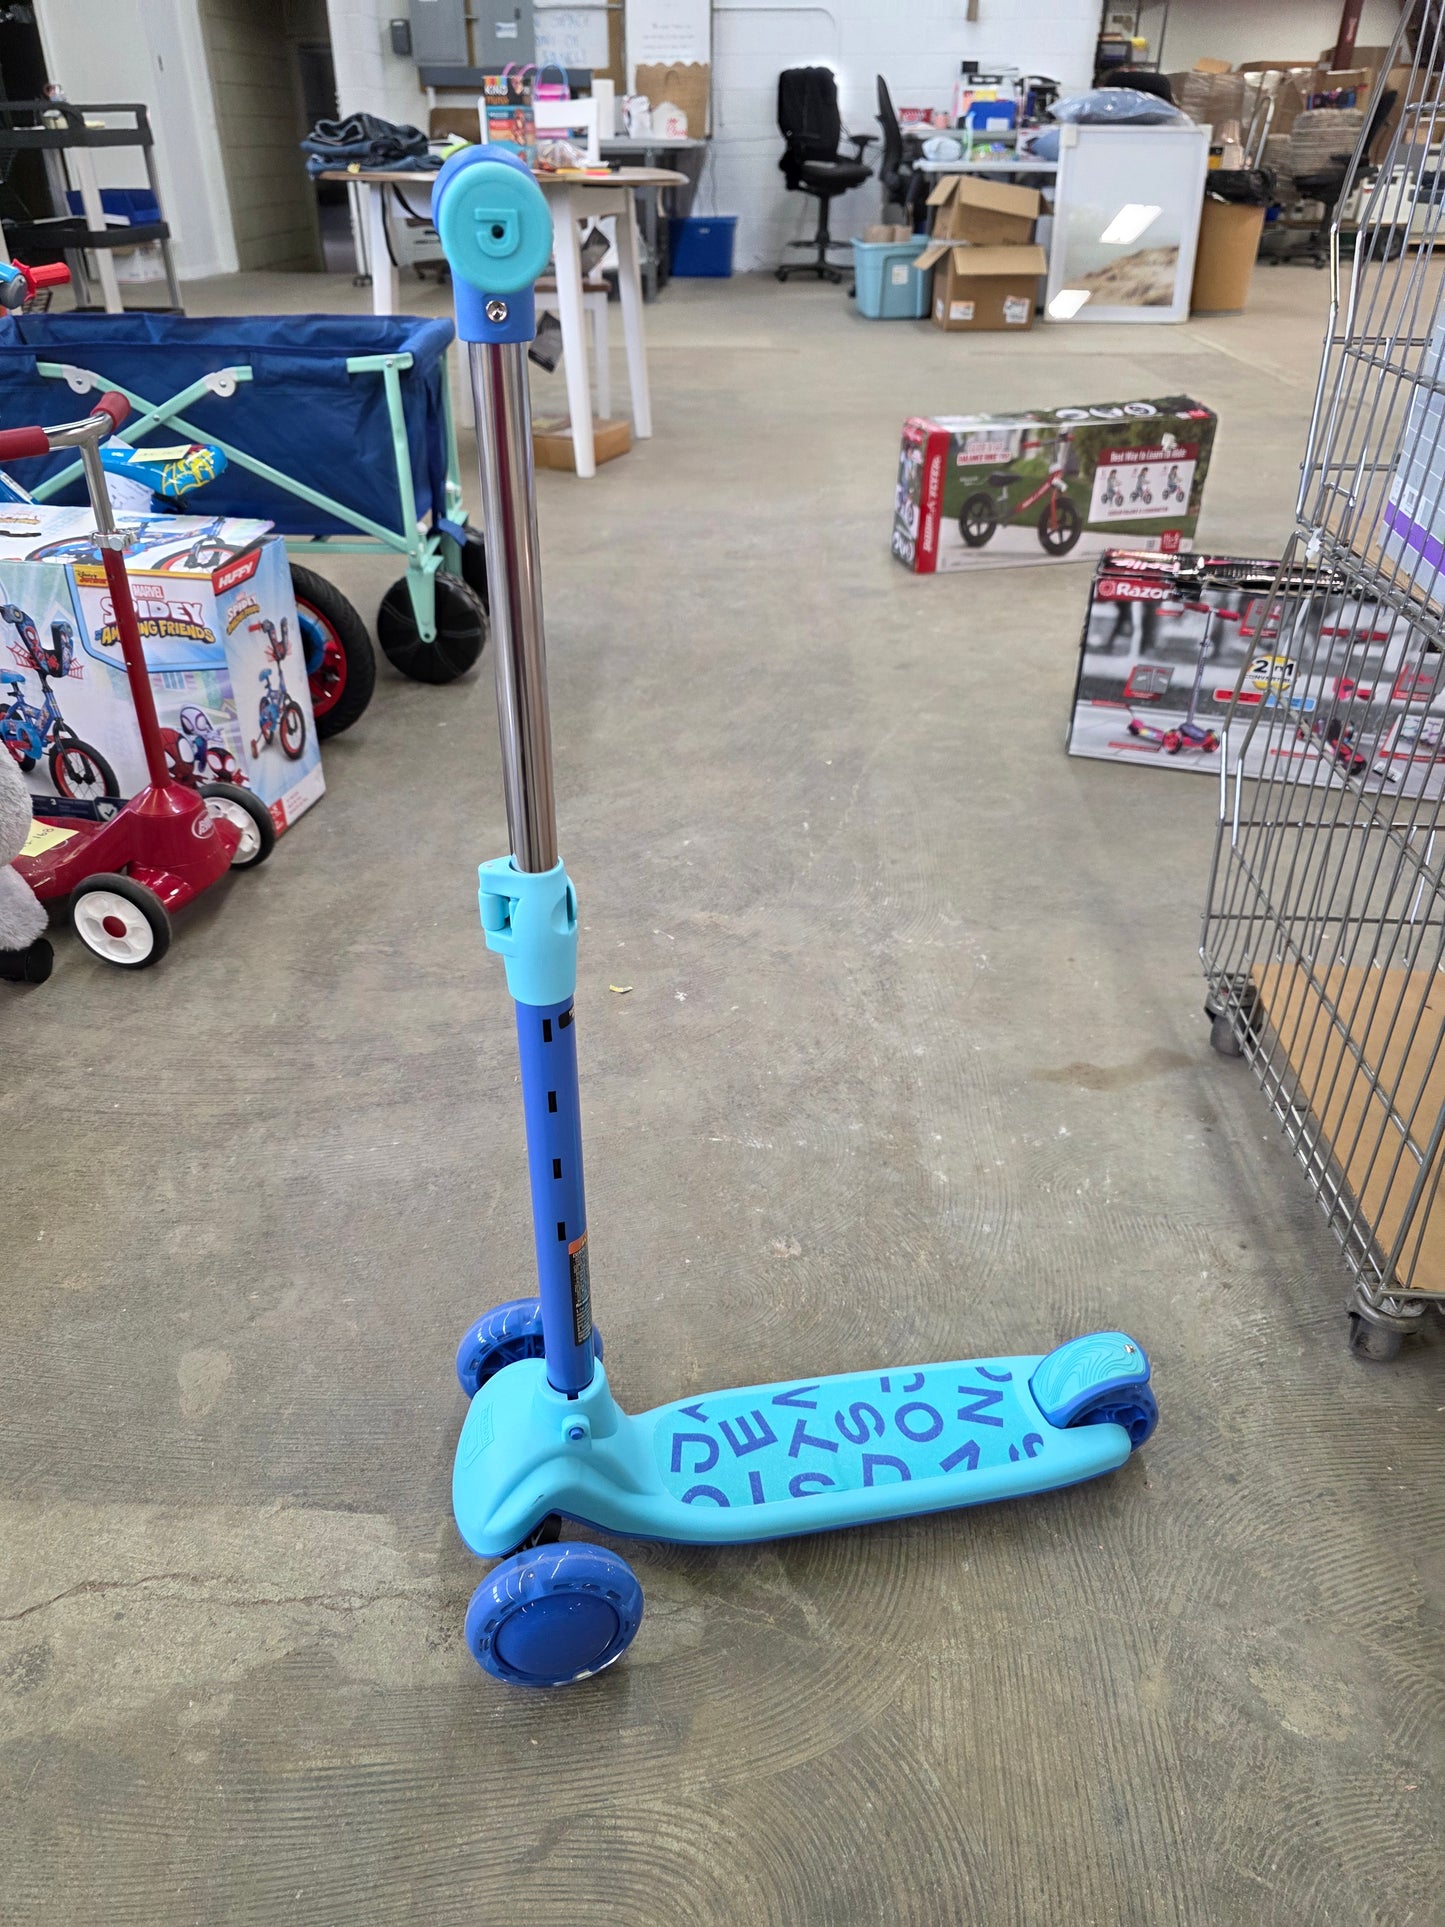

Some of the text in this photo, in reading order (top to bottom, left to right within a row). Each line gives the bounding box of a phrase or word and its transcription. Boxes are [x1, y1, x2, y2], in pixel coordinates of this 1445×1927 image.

[218, 561, 253, 589] HUFFY
[132, 584, 164, 598] MARVEL
[1116, 582, 1172, 600] Razor
[100, 597, 205, 627] SIDEY
[101, 620, 158, 646] AMING
[159, 620, 216, 644] FRIENDS
[1253, 660, 1269, 674] 2
